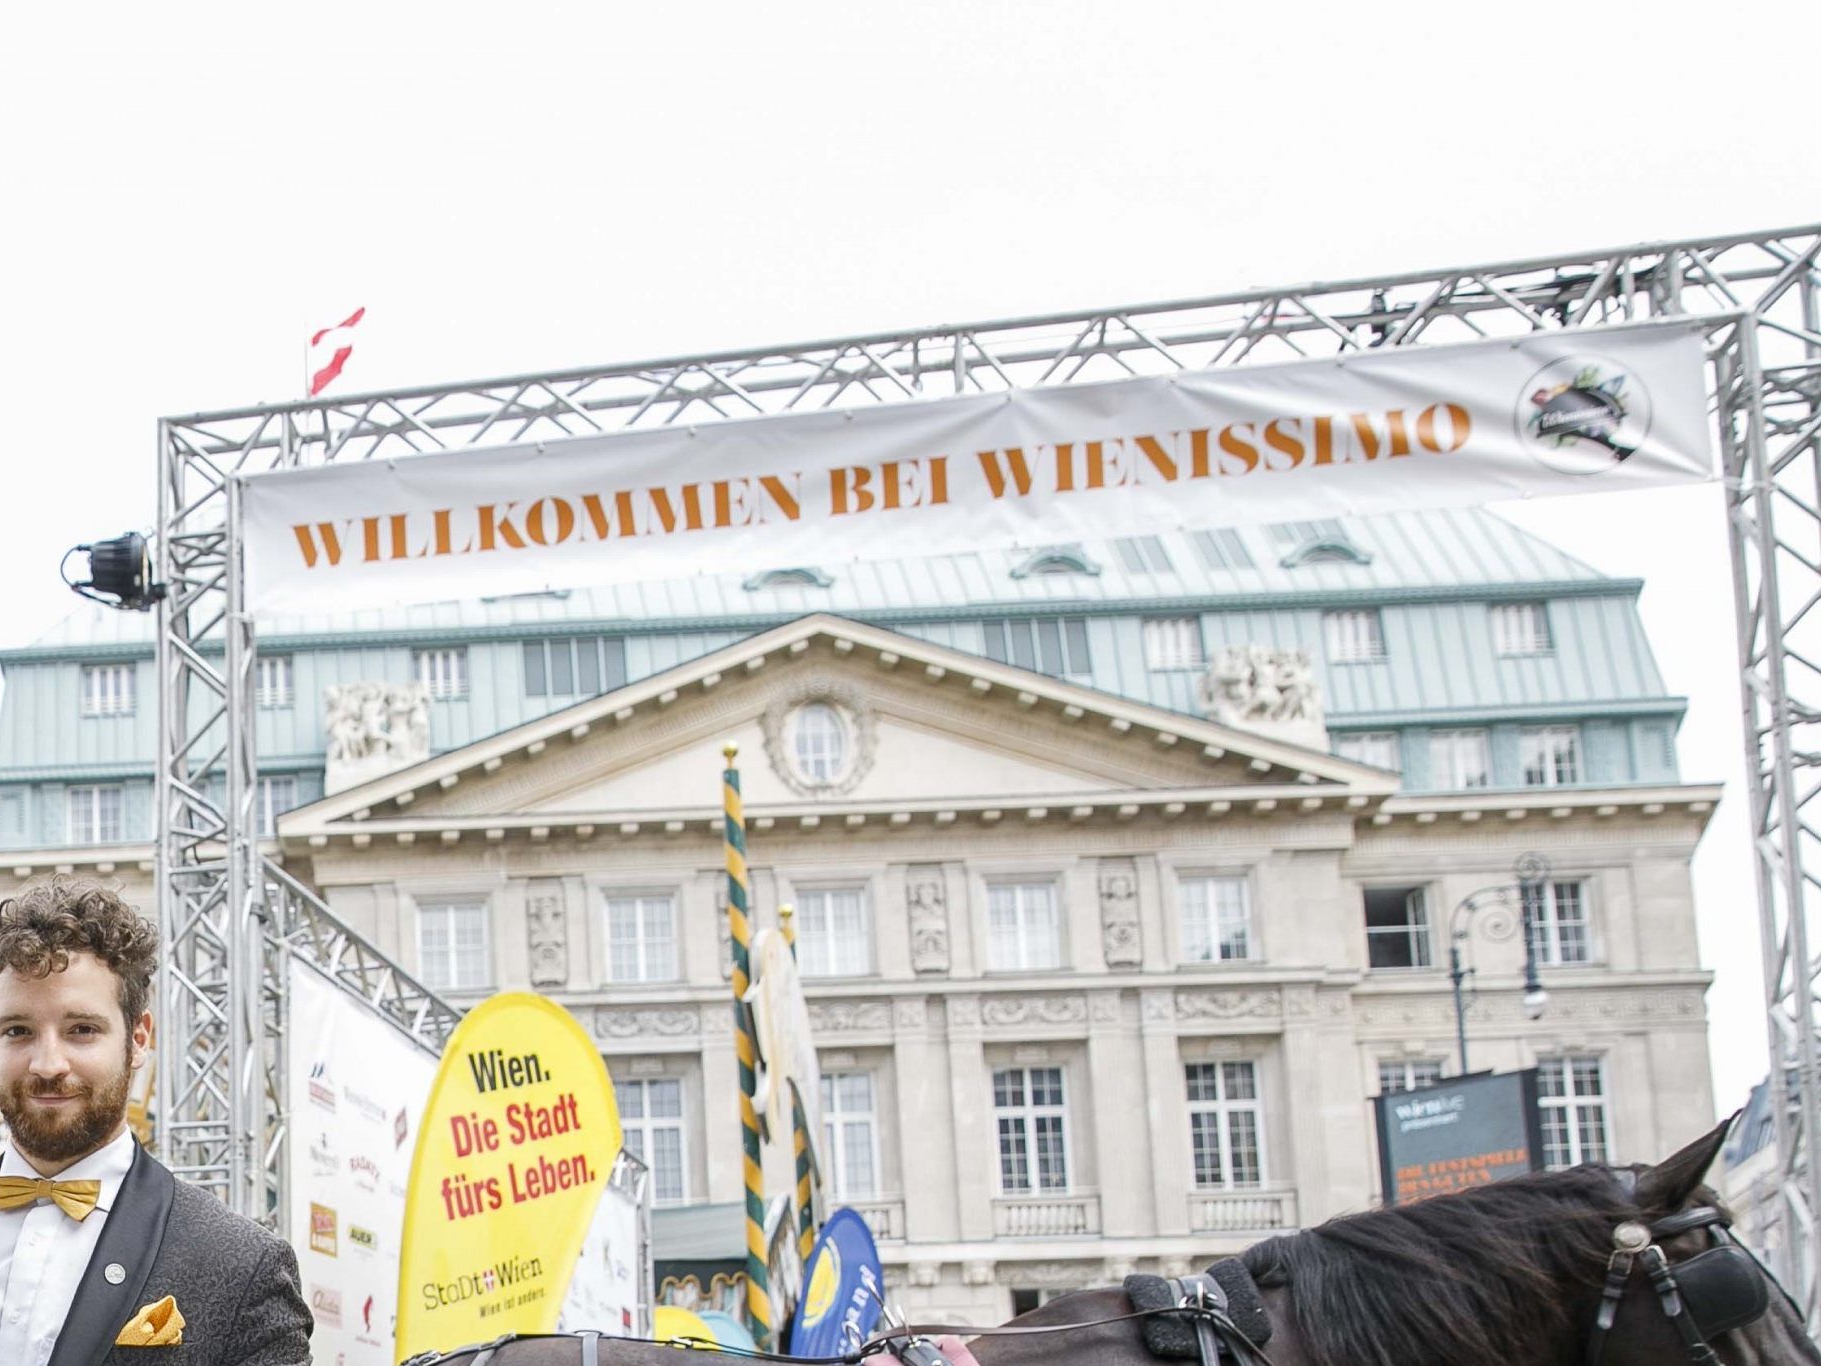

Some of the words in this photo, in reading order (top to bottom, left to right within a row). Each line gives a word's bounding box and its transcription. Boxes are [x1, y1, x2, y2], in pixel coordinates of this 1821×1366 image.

[291, 472, 803, 568] WILLKOMMEN
[829, 456, 952, 516] BEI
[975, 402, 1472, 499] WIENISSIMO
[468, 1049, 551, 1094] Wien.
[450, 1111, 500, 1158] Die
[505, 1092, 582, 1145] Stadt
[441, 1173, 502, 1221] fürs
[508, 1153, 596, 1204] Leben.
[349, 1227, 373, 1244] AUER
[494, 1255, 543, 1288] Wien
